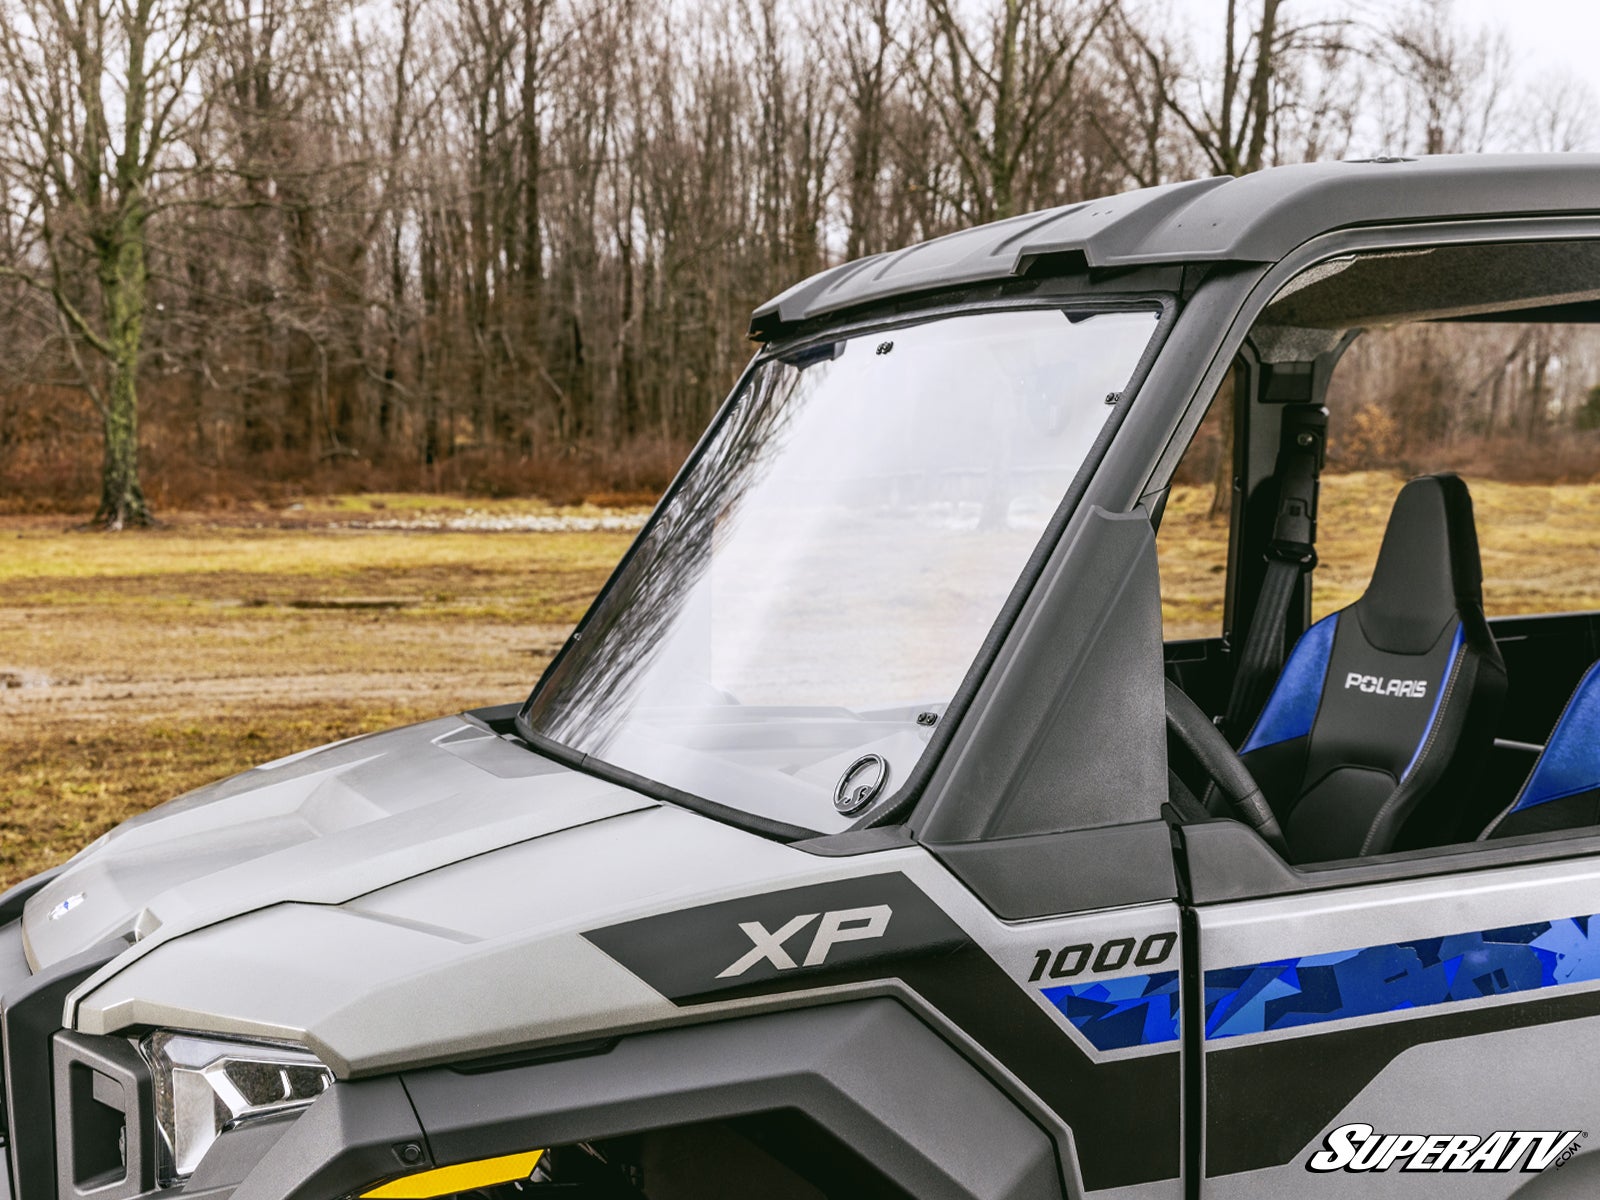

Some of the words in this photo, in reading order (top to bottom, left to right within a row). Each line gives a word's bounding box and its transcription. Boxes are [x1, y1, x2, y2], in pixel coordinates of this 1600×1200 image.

[1344, 672, 1427, 698] POLARIS
[714, 904, 893, 979] XP
[1028, 931, 1178, 982] 1000
